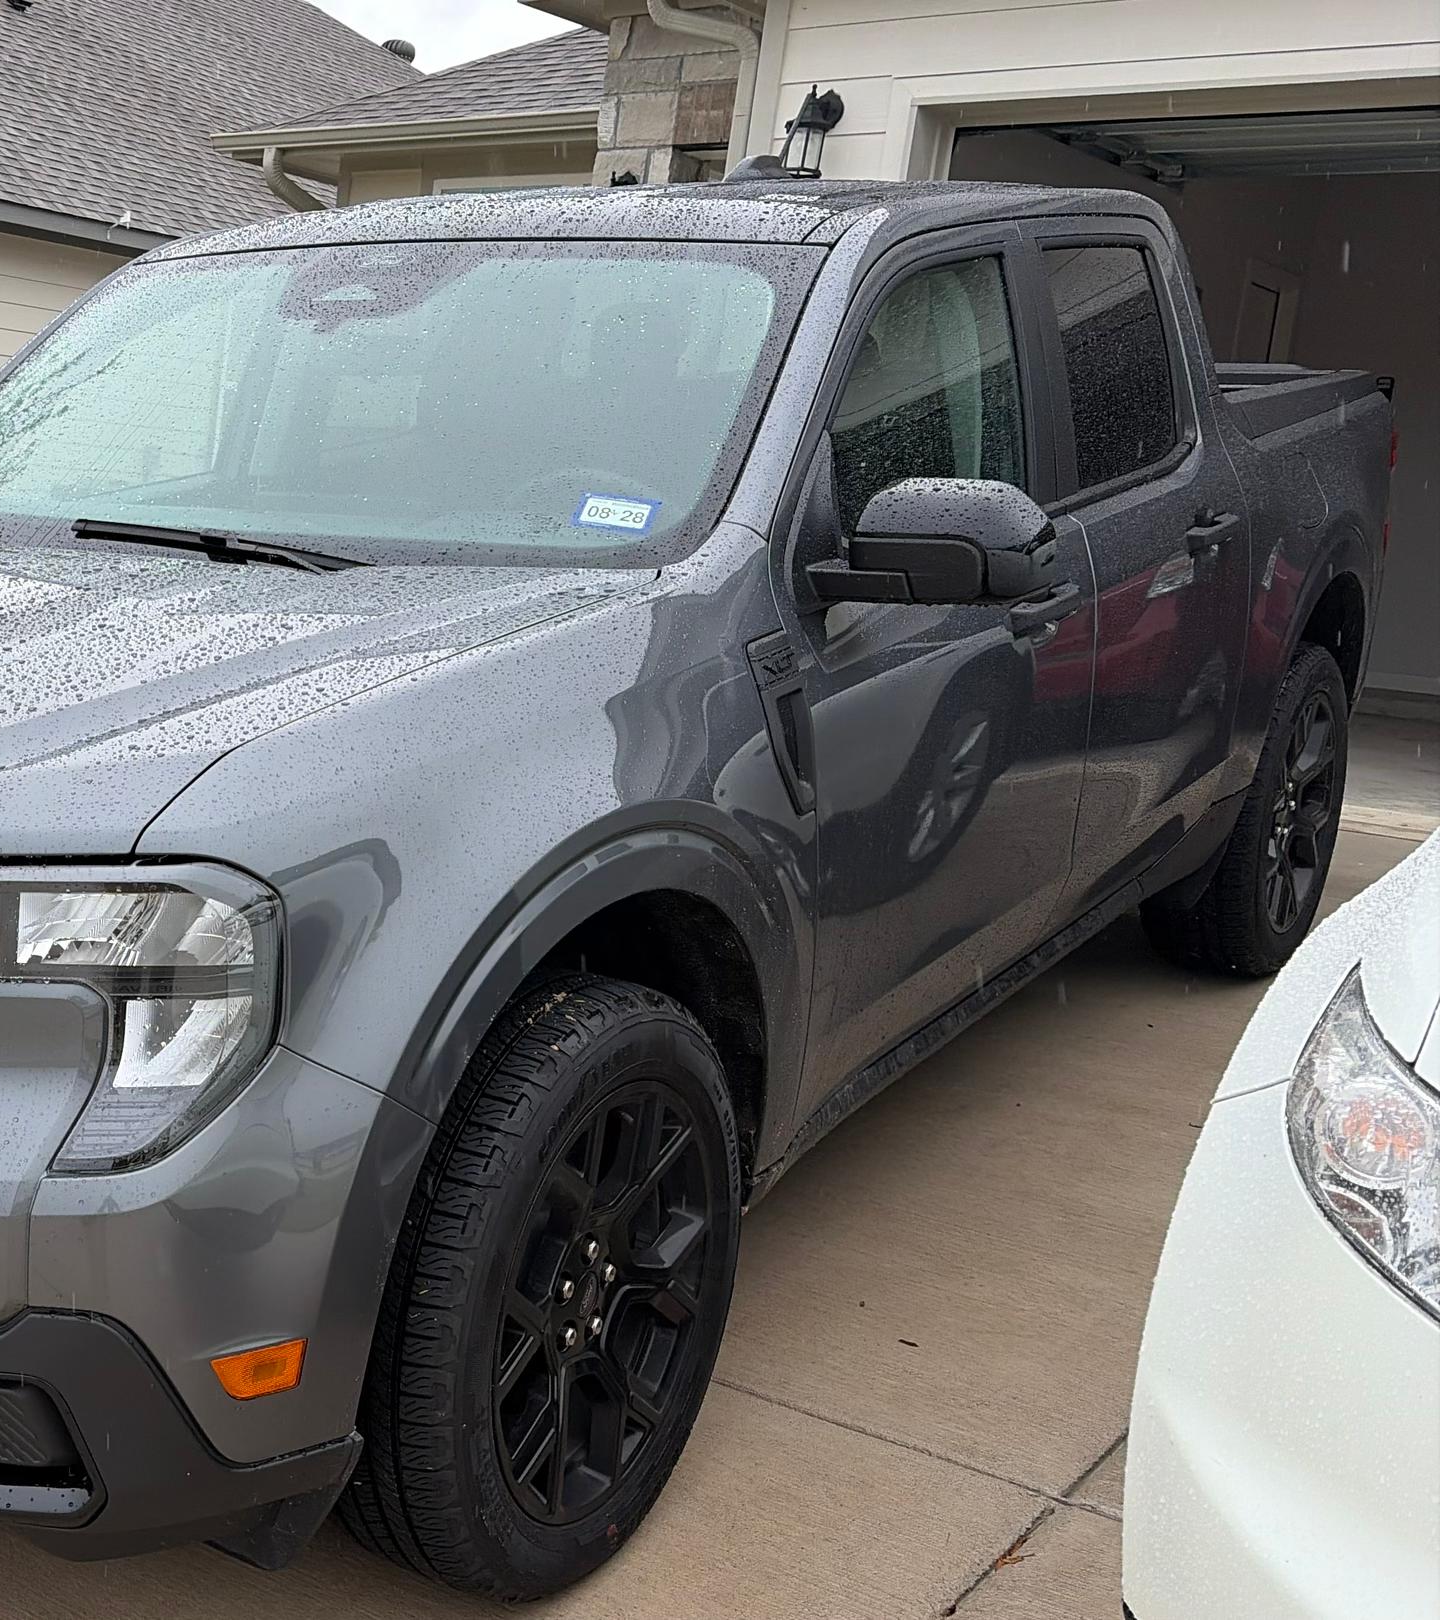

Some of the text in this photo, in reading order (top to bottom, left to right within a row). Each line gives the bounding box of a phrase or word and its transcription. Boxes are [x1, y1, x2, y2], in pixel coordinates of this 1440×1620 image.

[587, 505, 611, 519] 08
[620, 510, 645, 524] 28
[762, 652, 795, 679] XLT
